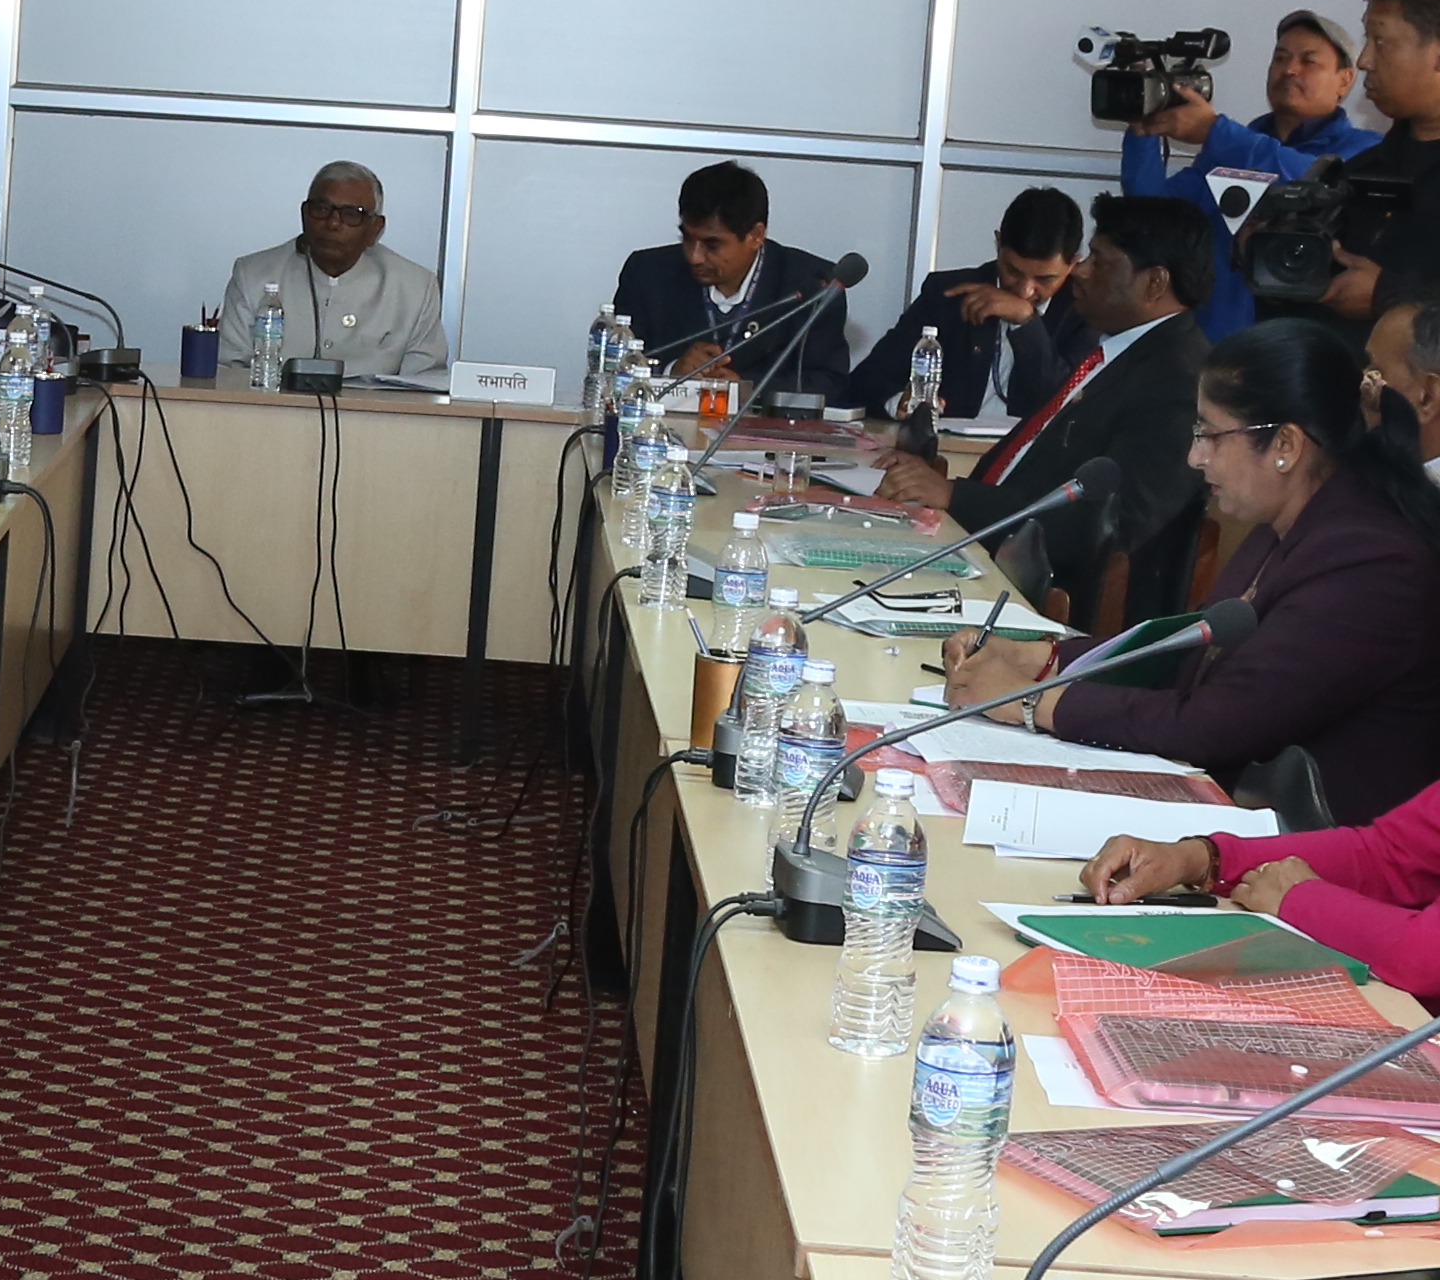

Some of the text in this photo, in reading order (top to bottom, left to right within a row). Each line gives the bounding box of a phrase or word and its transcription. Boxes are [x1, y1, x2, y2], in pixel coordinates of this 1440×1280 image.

[476, 372, 528, 390] सभापति
[851, 870, 880, 885] AQUA
[924, 1079, 960, 1098] AQUA
